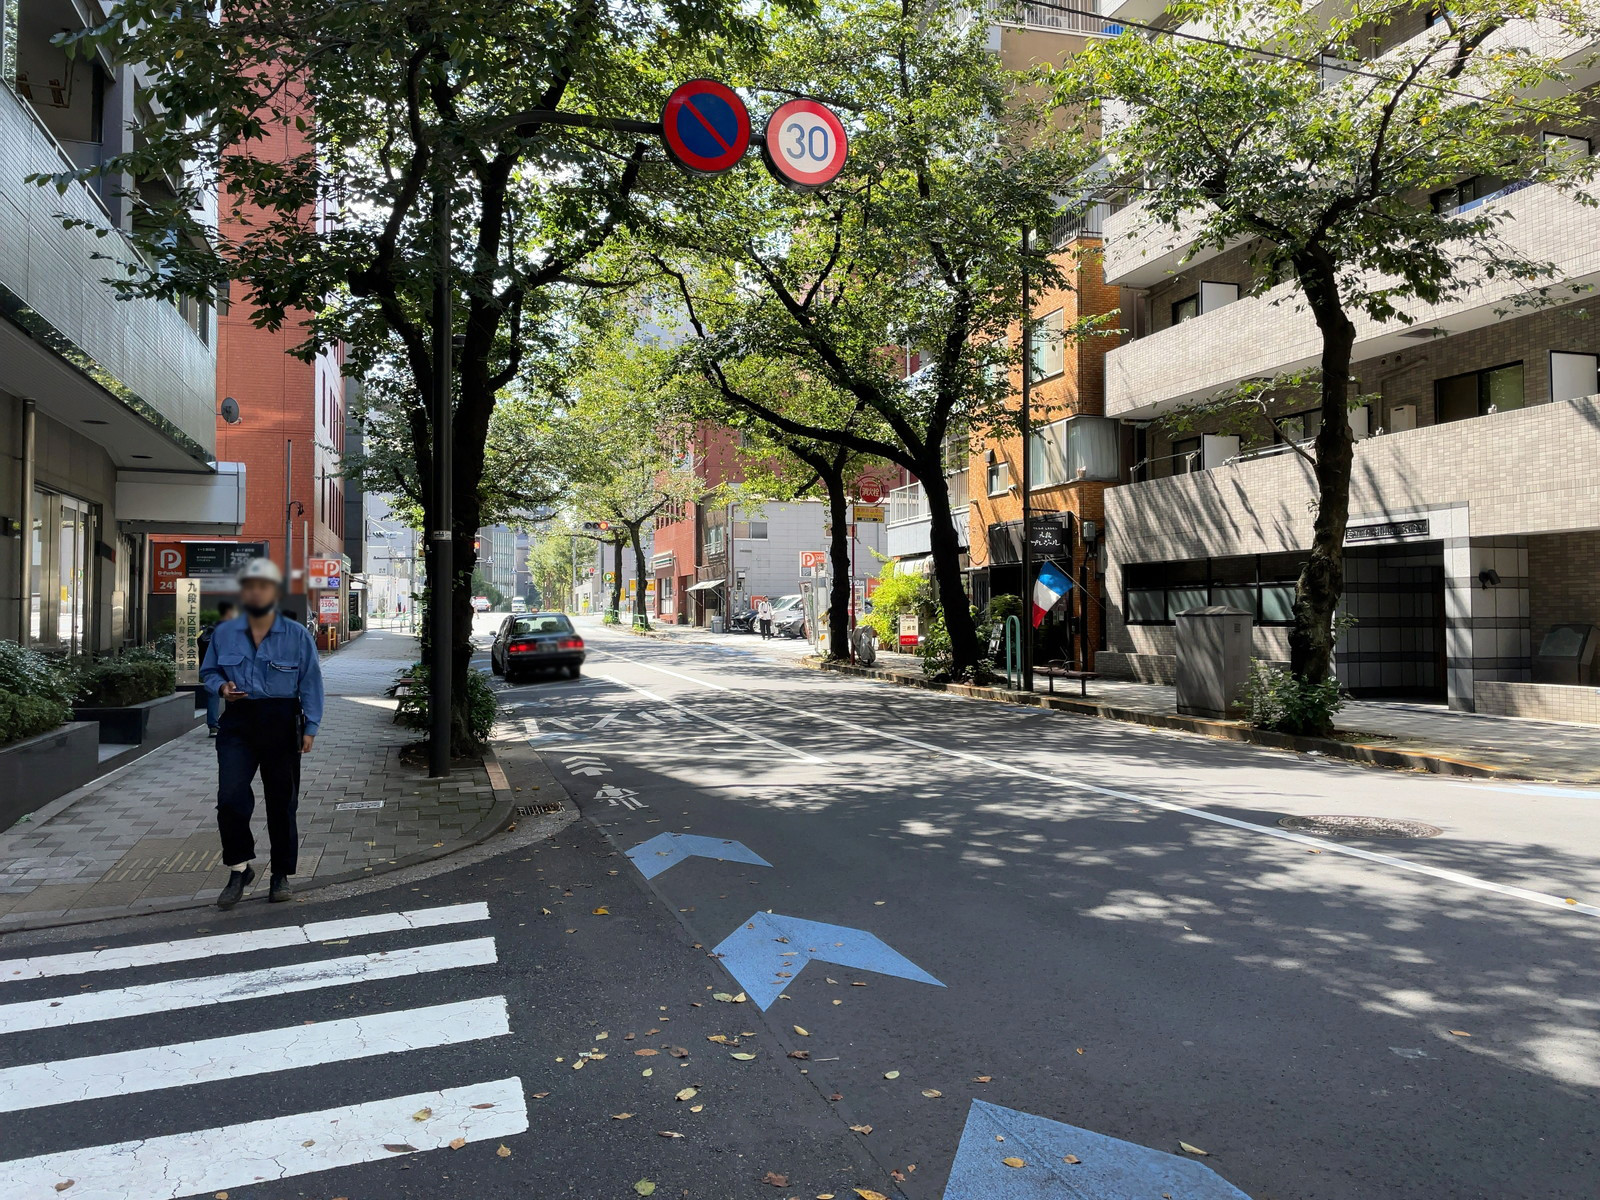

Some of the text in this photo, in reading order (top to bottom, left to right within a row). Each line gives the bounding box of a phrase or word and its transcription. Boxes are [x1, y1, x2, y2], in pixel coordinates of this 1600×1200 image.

[786, 122, 829, 162] 30
[861, 487, 880, 497] 消火栓
[187, 581, 197, 671] 九段上区民集会室
